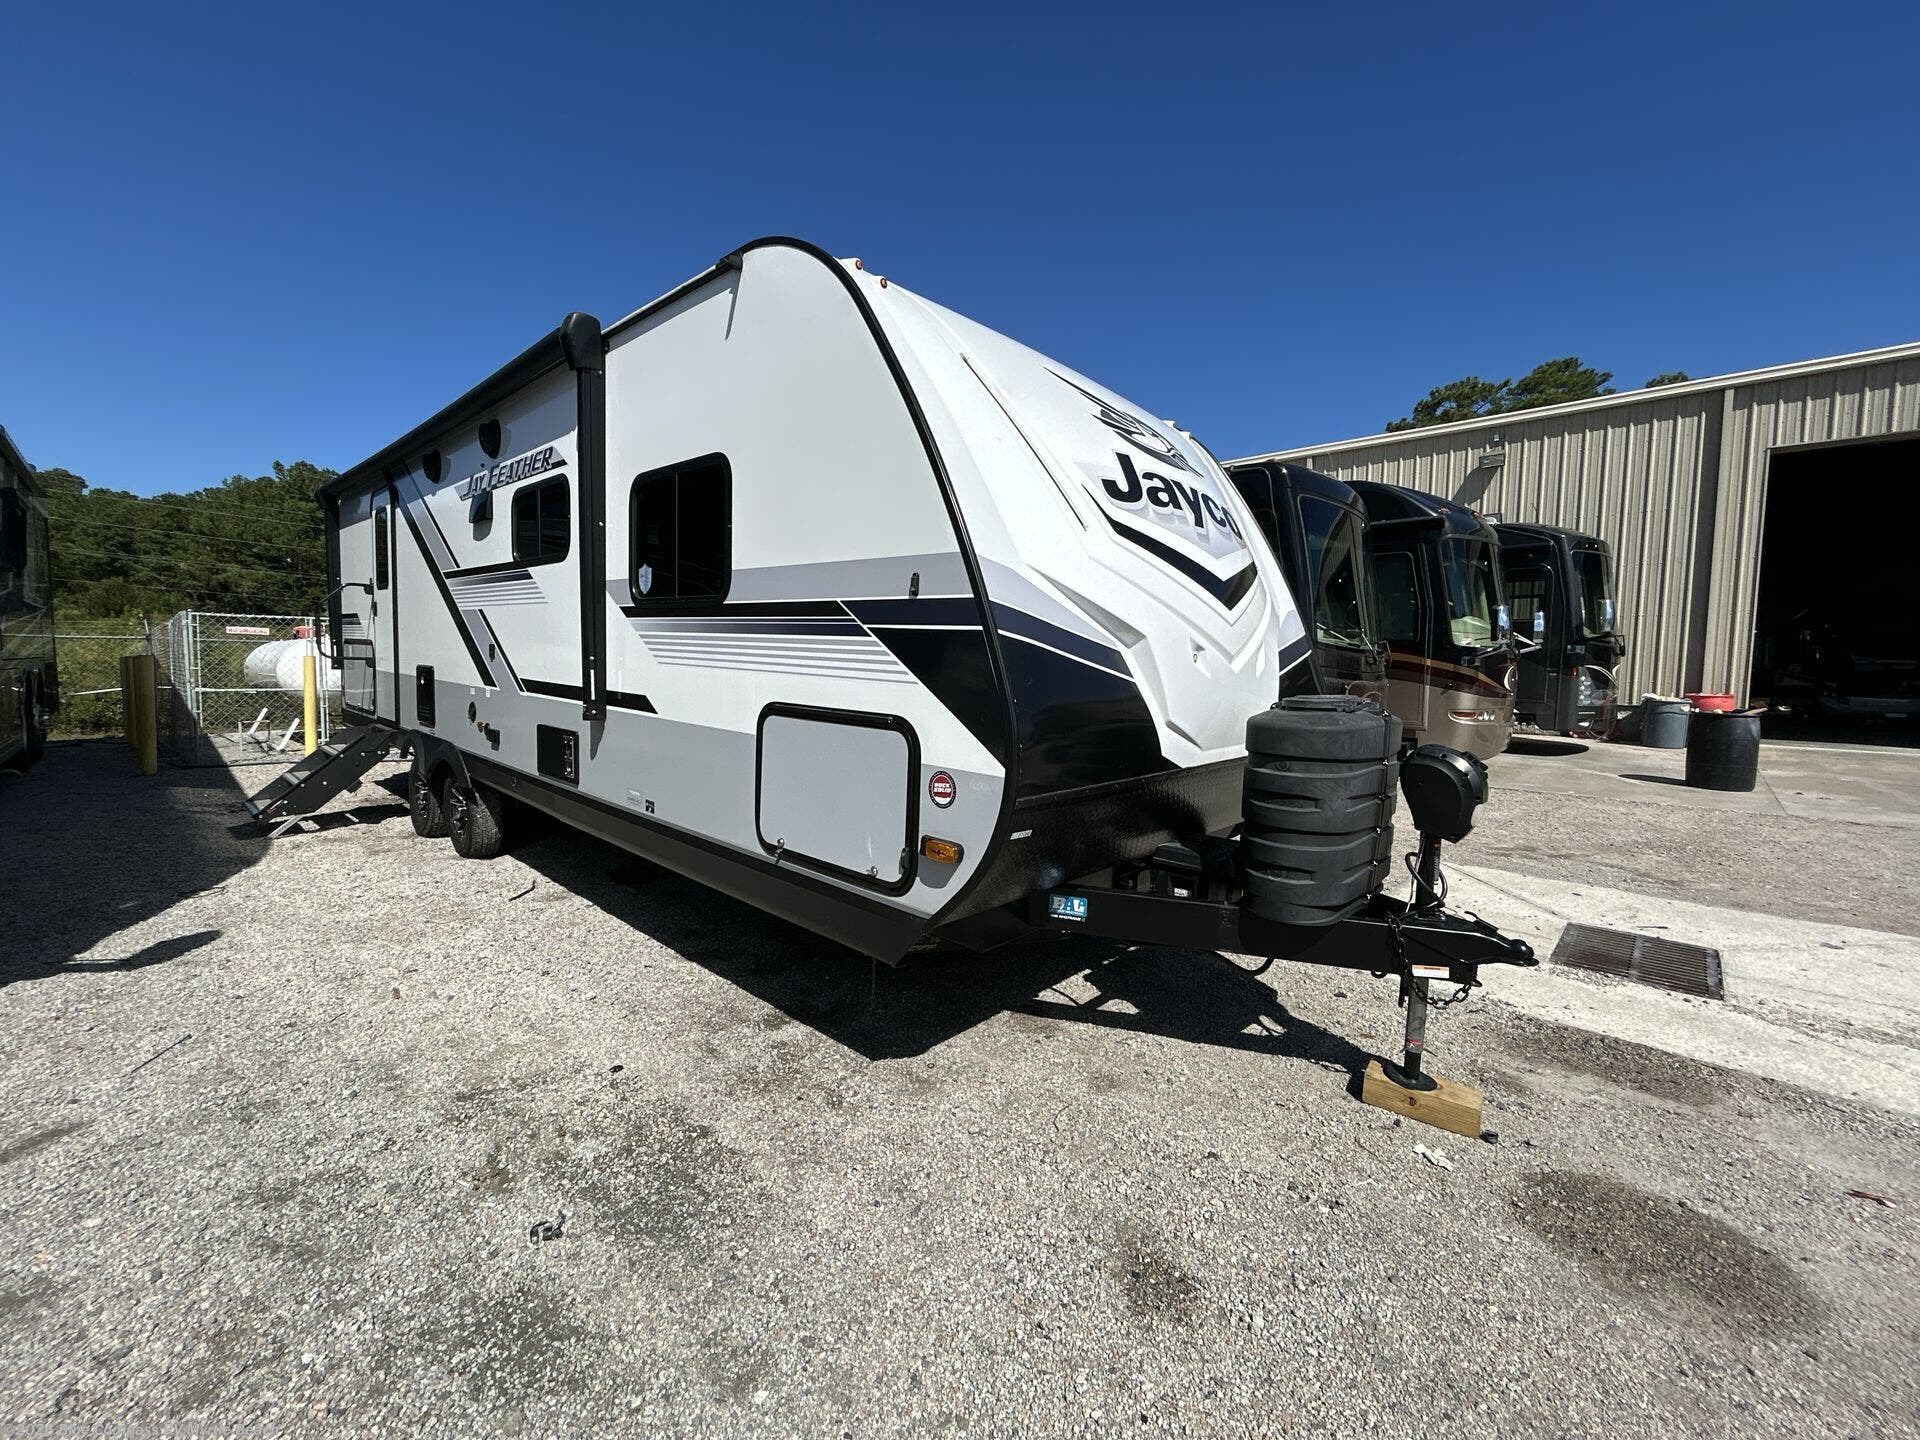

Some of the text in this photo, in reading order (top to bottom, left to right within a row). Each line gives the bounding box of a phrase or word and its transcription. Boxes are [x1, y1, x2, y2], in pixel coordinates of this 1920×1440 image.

[460, 445, 554, 501] JAY FEATHER
[1101, 451, 1243, 540] Jayco
